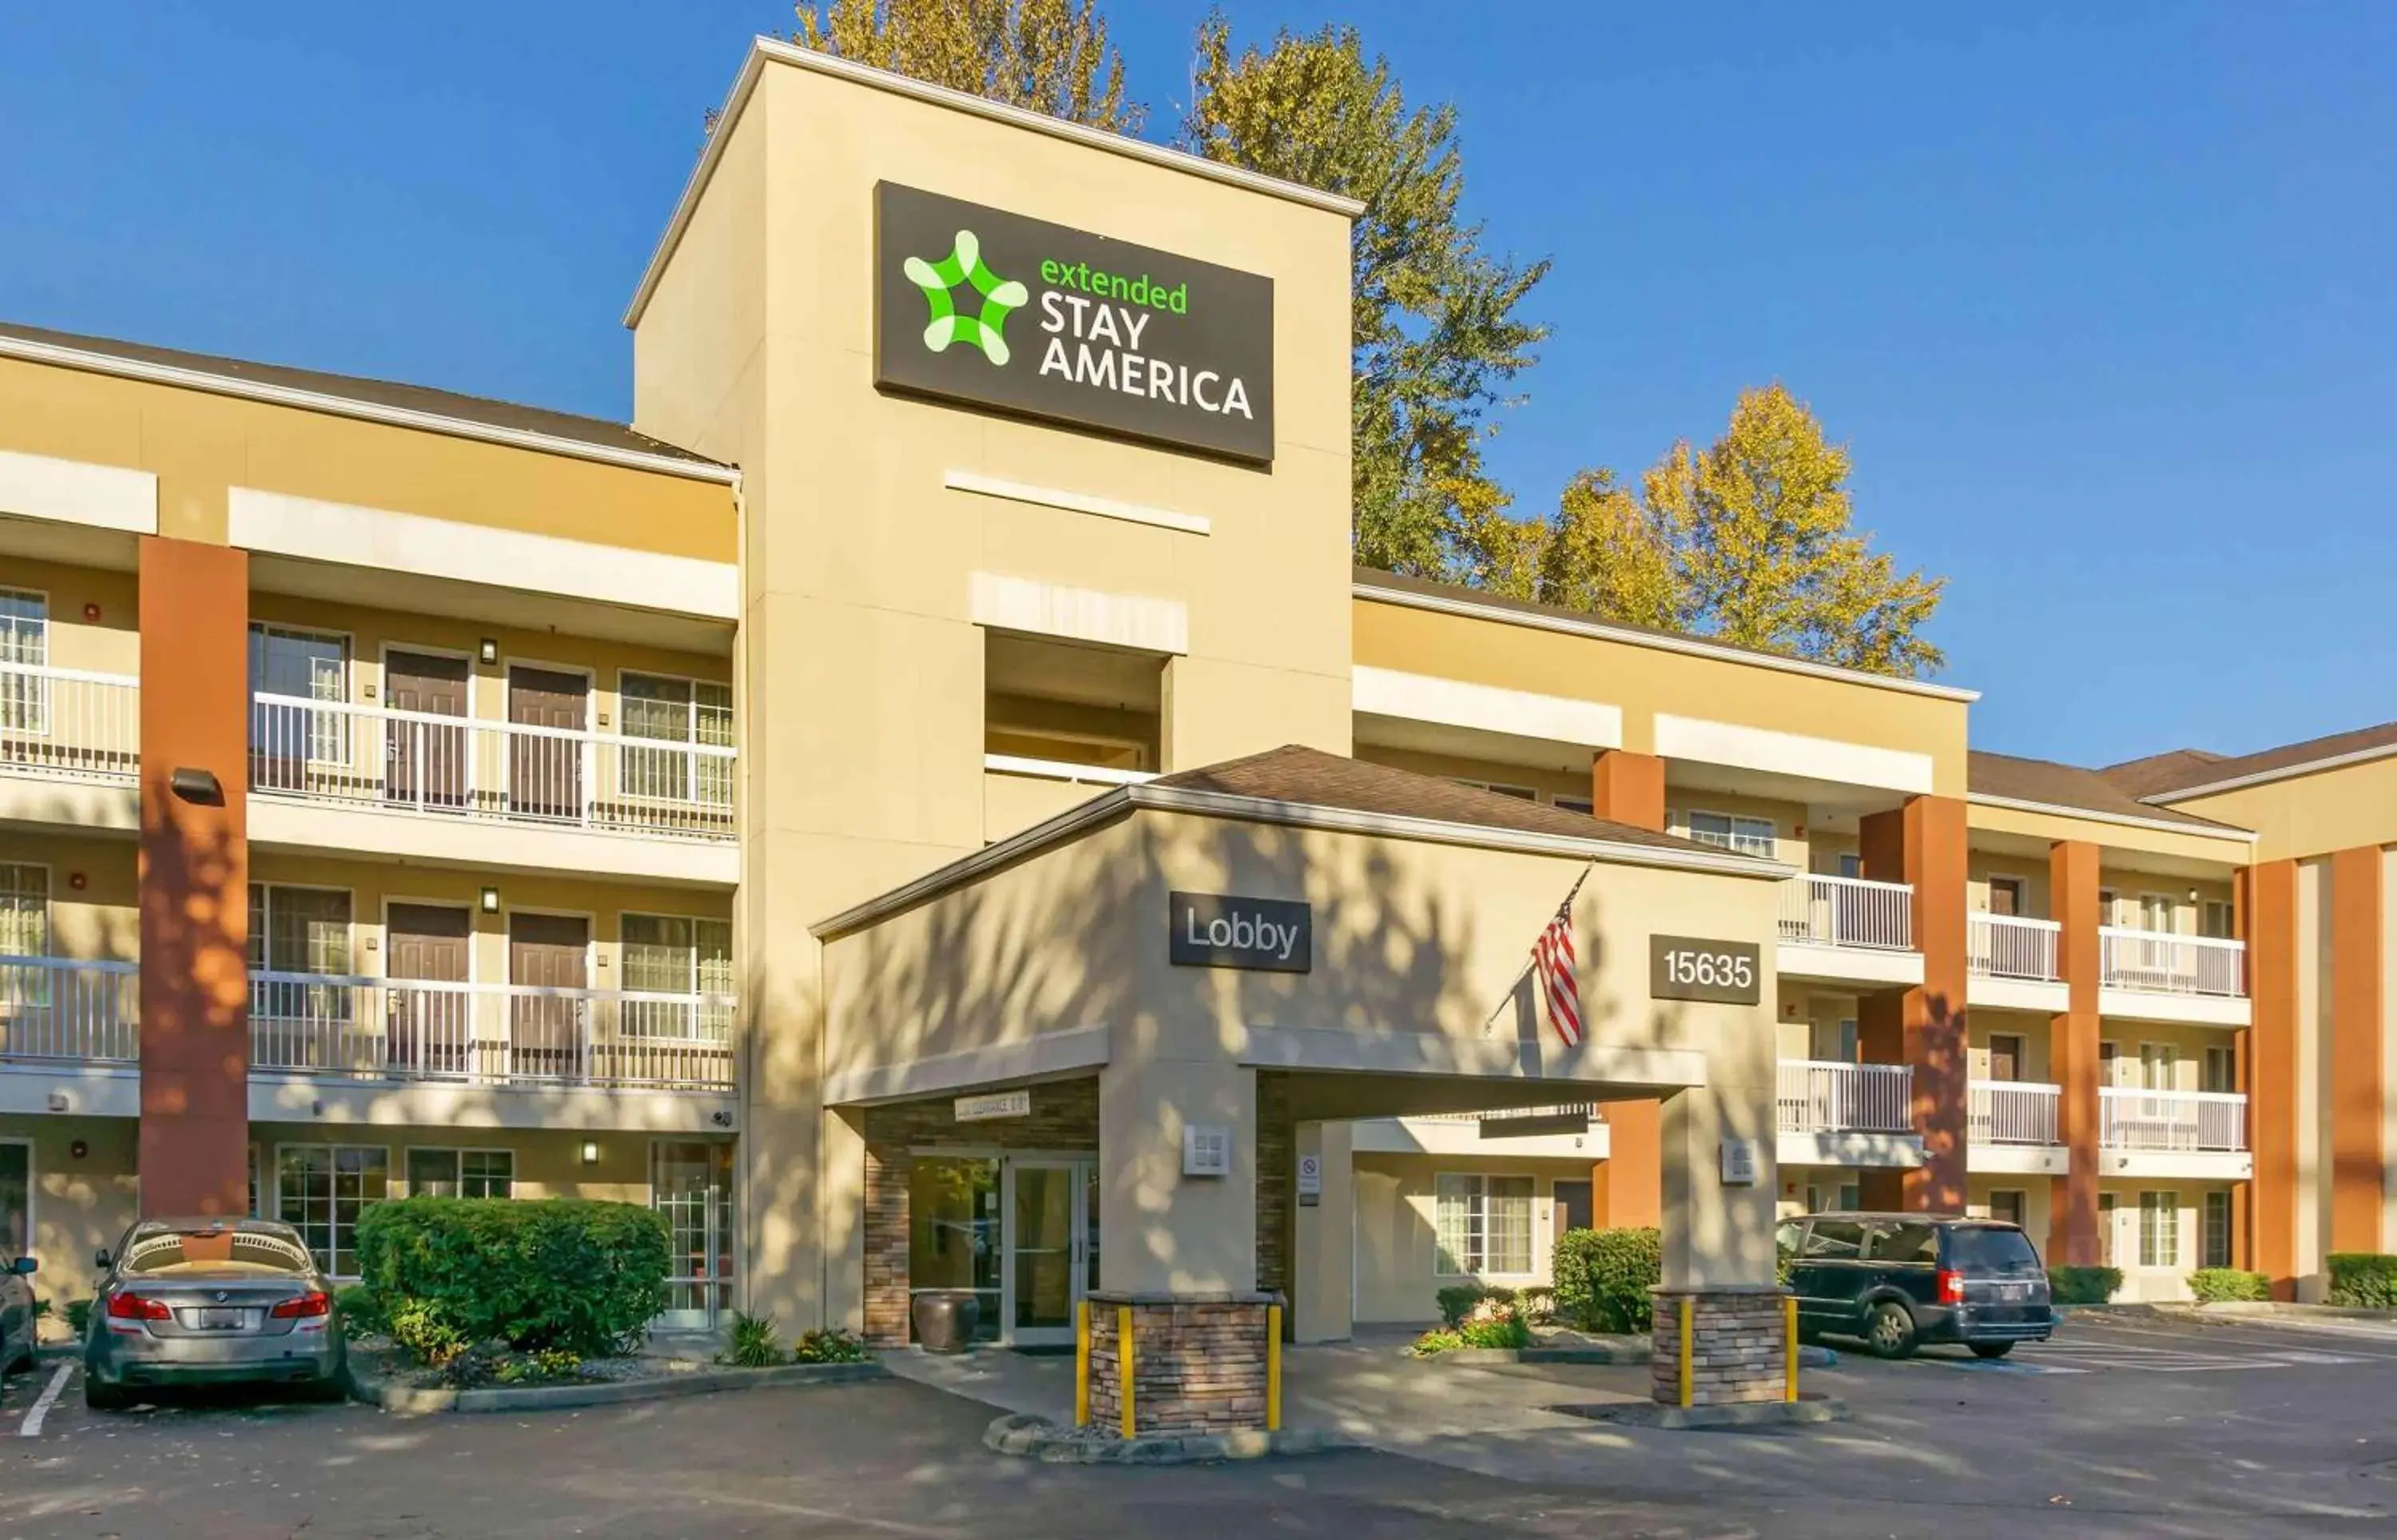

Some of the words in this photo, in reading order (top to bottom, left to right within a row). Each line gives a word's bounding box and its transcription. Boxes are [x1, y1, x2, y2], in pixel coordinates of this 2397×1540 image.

[1040, 258, 1187, 314] extended
[1040, 291, 1151, 351] STAY
[1039, 337, 1254, 419] AMERICA
[1187, 907, 1298, 960] Lobby
[1664, 950, 1752, 988] 15635
